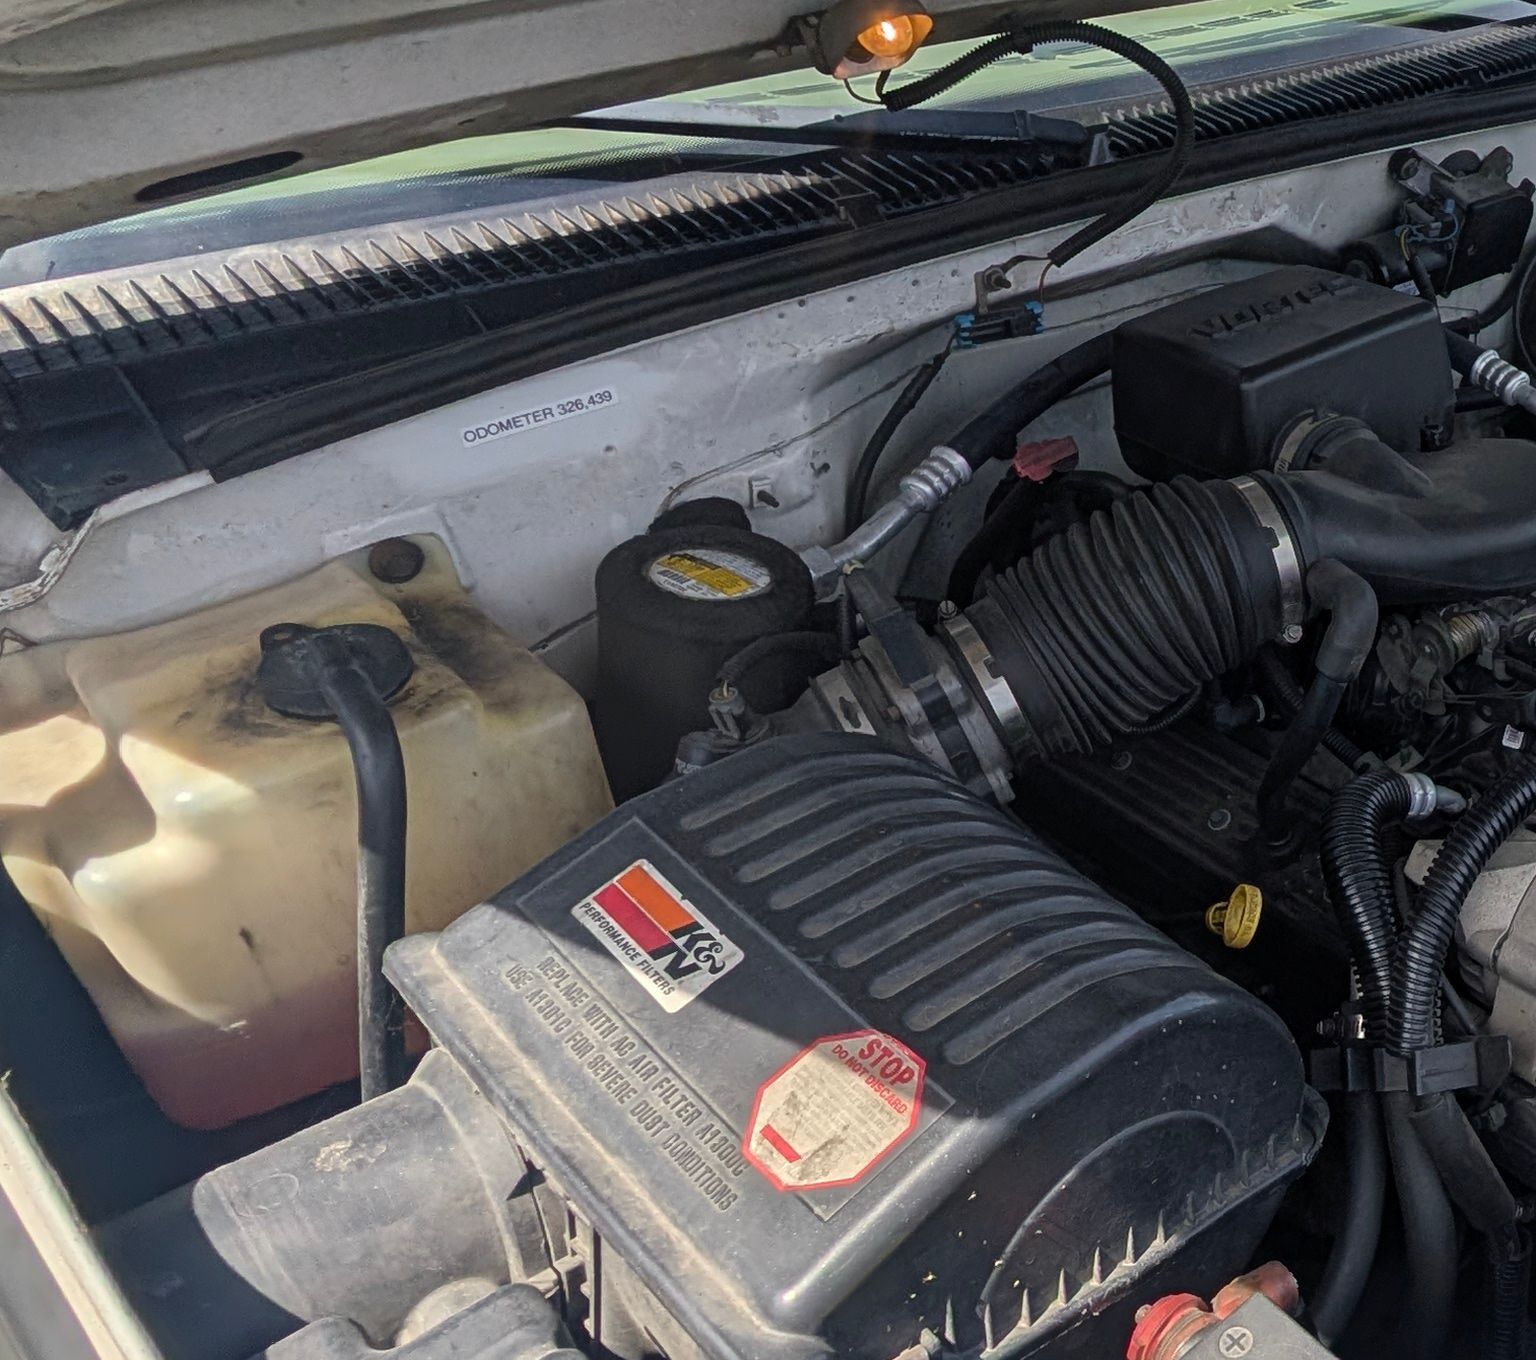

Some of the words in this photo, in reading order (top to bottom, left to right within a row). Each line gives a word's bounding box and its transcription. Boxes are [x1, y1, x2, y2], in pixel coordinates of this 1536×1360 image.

[463, 407, 555, 443] ODOMETER
[580, 902, 640, 961] PERFORMANCE
[637, 959, 675, 996] FILTERS
[533, 957, 590, 1007] REPLACE
[579, 1004, 620, 1039] WITH
[609, 1034, 636, 1057] AC
[627, 1052, 659, 1082] AIR
[652, 1076, 701, 1128] FILTER
[831, 1044, 849, 1060] DO
[844, 1056, 868, 1078] NOT
[864, 1074, 907, 1114] DISCARD
[857, 1037, 916, 1090] STOP
[500, 964, 535, 989] USE
[563, 1031, 596, 1058] FOR
[585, 1054, 636, 1104] SEVERE
[629, 1099, 668, 1139] DUST
[662, 1131, 736, 1215] CONDITIONS
